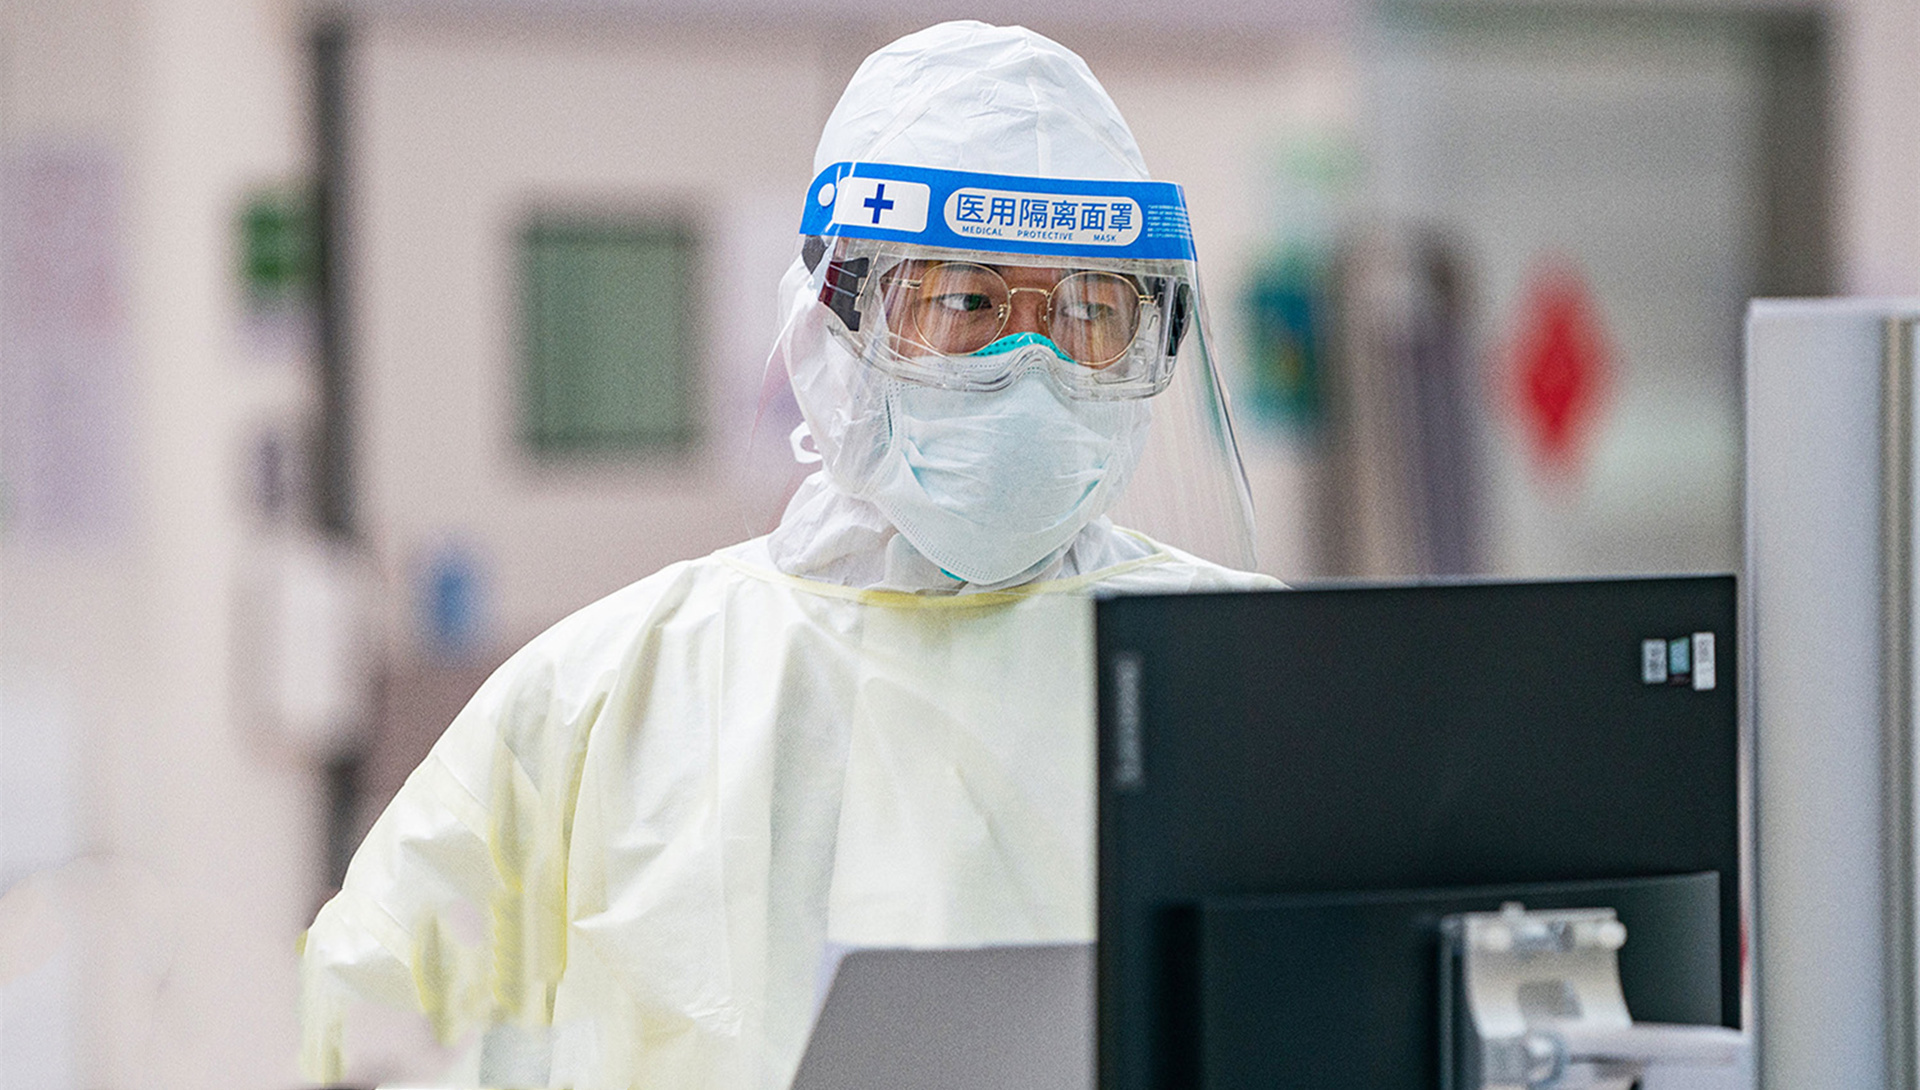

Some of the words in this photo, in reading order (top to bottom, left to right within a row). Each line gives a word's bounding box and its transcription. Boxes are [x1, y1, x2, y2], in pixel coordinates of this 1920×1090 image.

[956, 193, 1133, 232] 医用隔离面罩
[962, 225, 1003, 236] MEDICAL
[1017, 230, 1073, 241] PROTECTIVE
[1093, 234, 1117, 243] MASK
